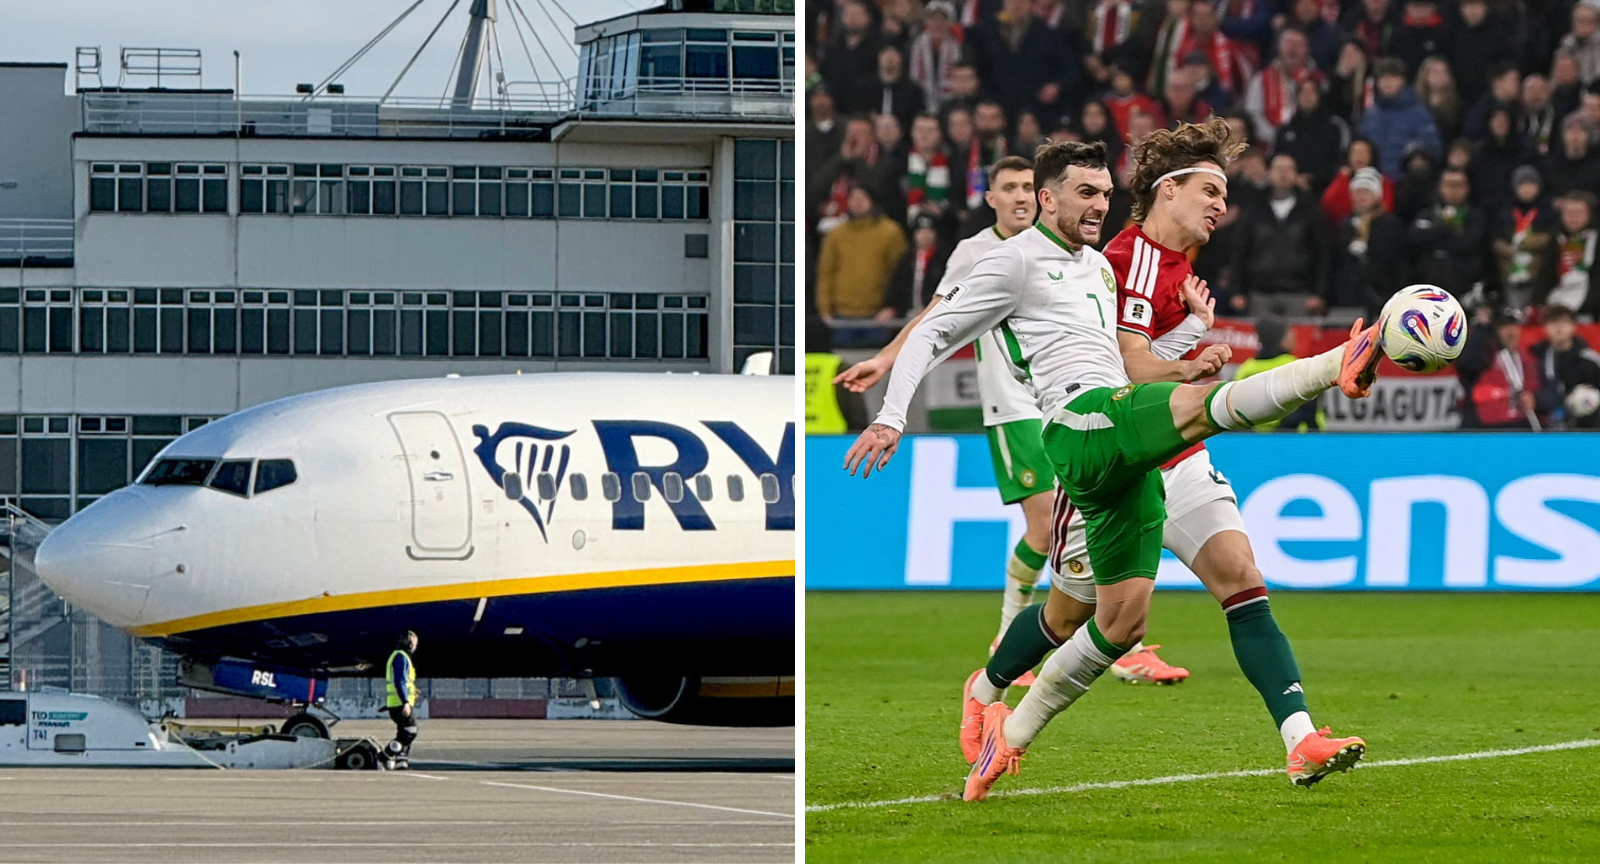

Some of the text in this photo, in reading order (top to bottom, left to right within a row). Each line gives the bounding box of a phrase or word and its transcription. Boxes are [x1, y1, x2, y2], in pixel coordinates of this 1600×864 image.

[1085, 292, 1105, 329] 7
[590, 419, 795, 531] RY
[904, 437, 1600, 588] Hens
[251, 669, 277, 688] RSL
